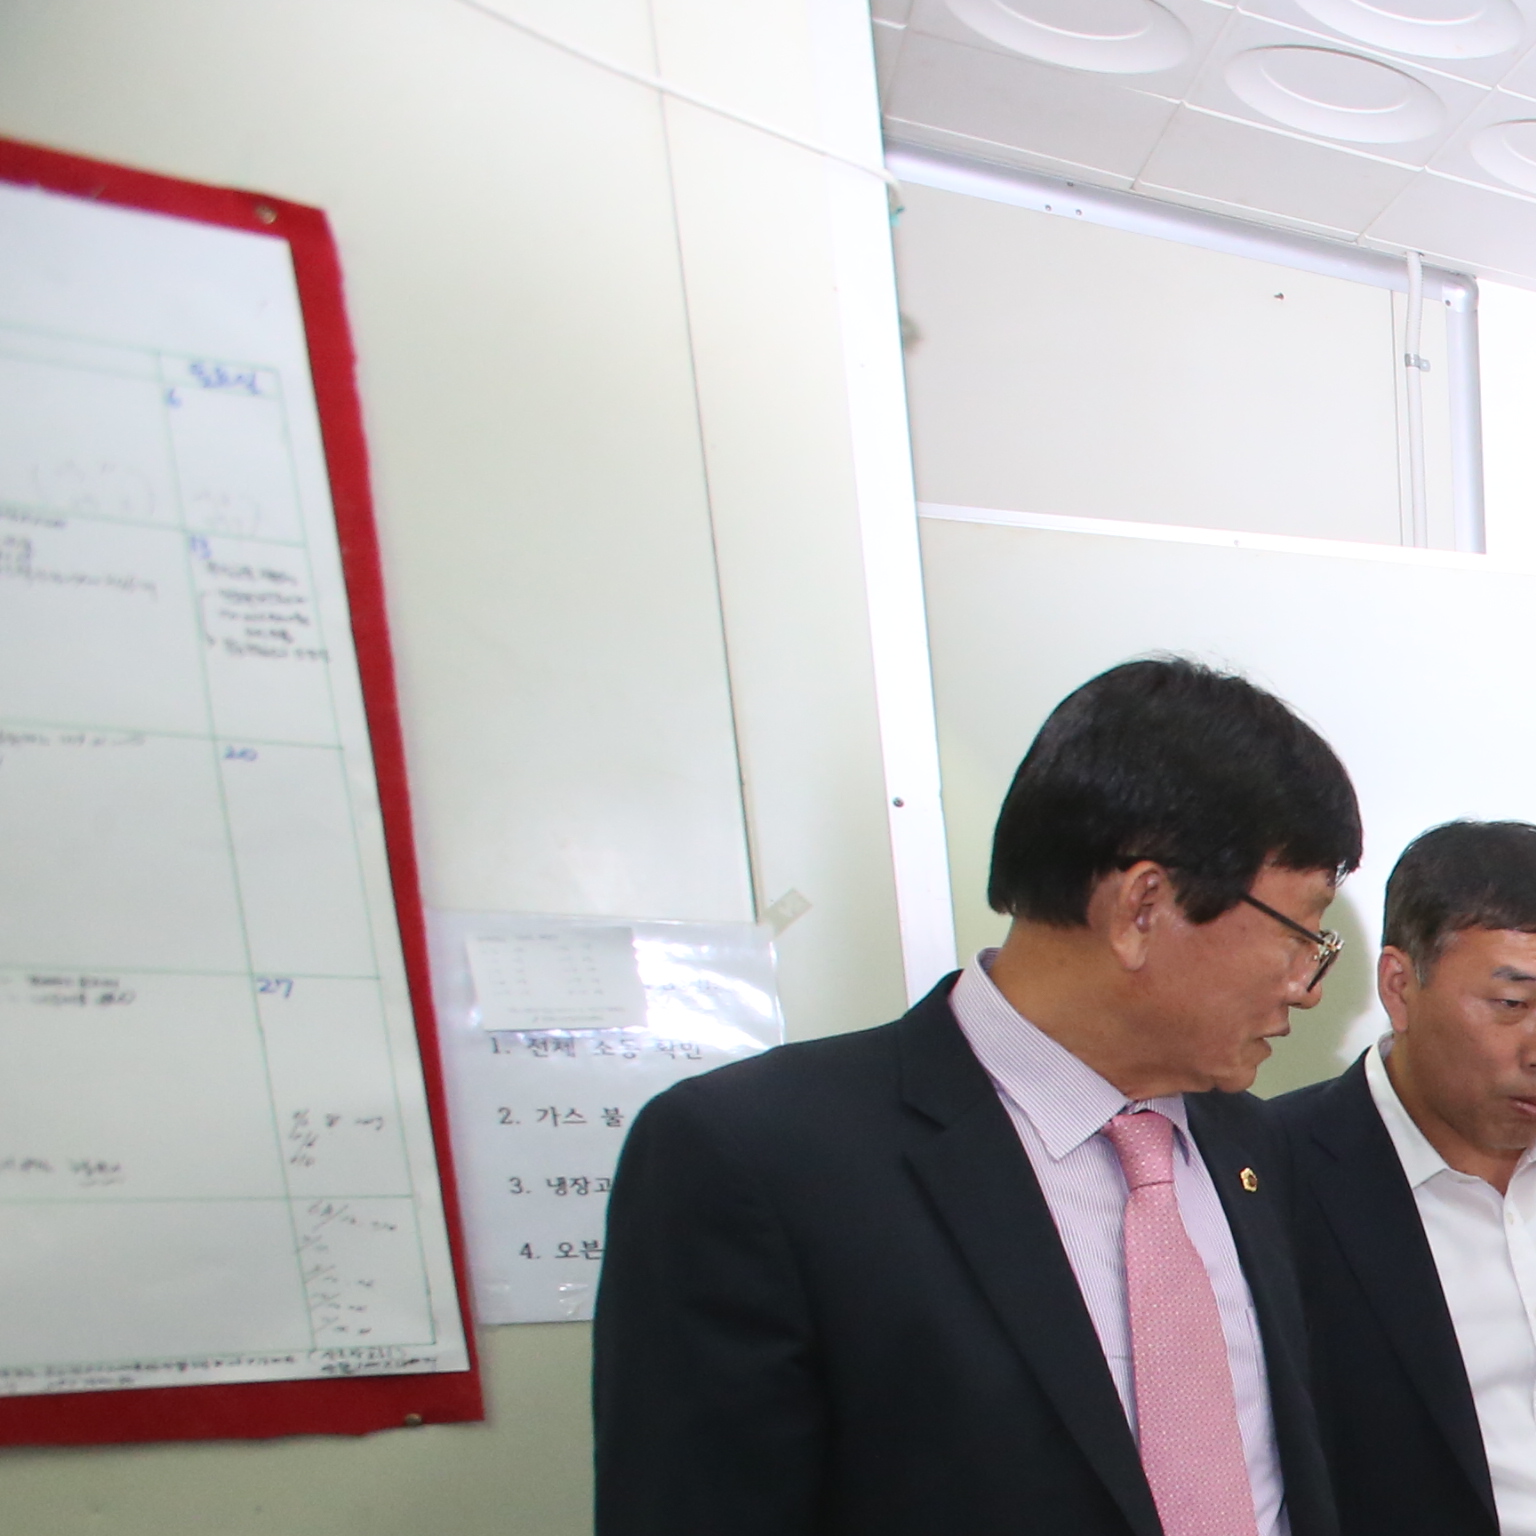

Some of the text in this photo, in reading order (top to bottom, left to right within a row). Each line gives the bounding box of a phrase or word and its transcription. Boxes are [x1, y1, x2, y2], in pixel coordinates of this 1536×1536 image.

[256, 977, 293, 998] 27
[490, 1037, 511, 1055] 1.
[527, 1037, 576, 1059] 전체
[499, 1106, 625, 1128] 2. 가스 불
[509, 1177, 531, 1195] 3.
[519, 1243, 541, 1260] 4.
